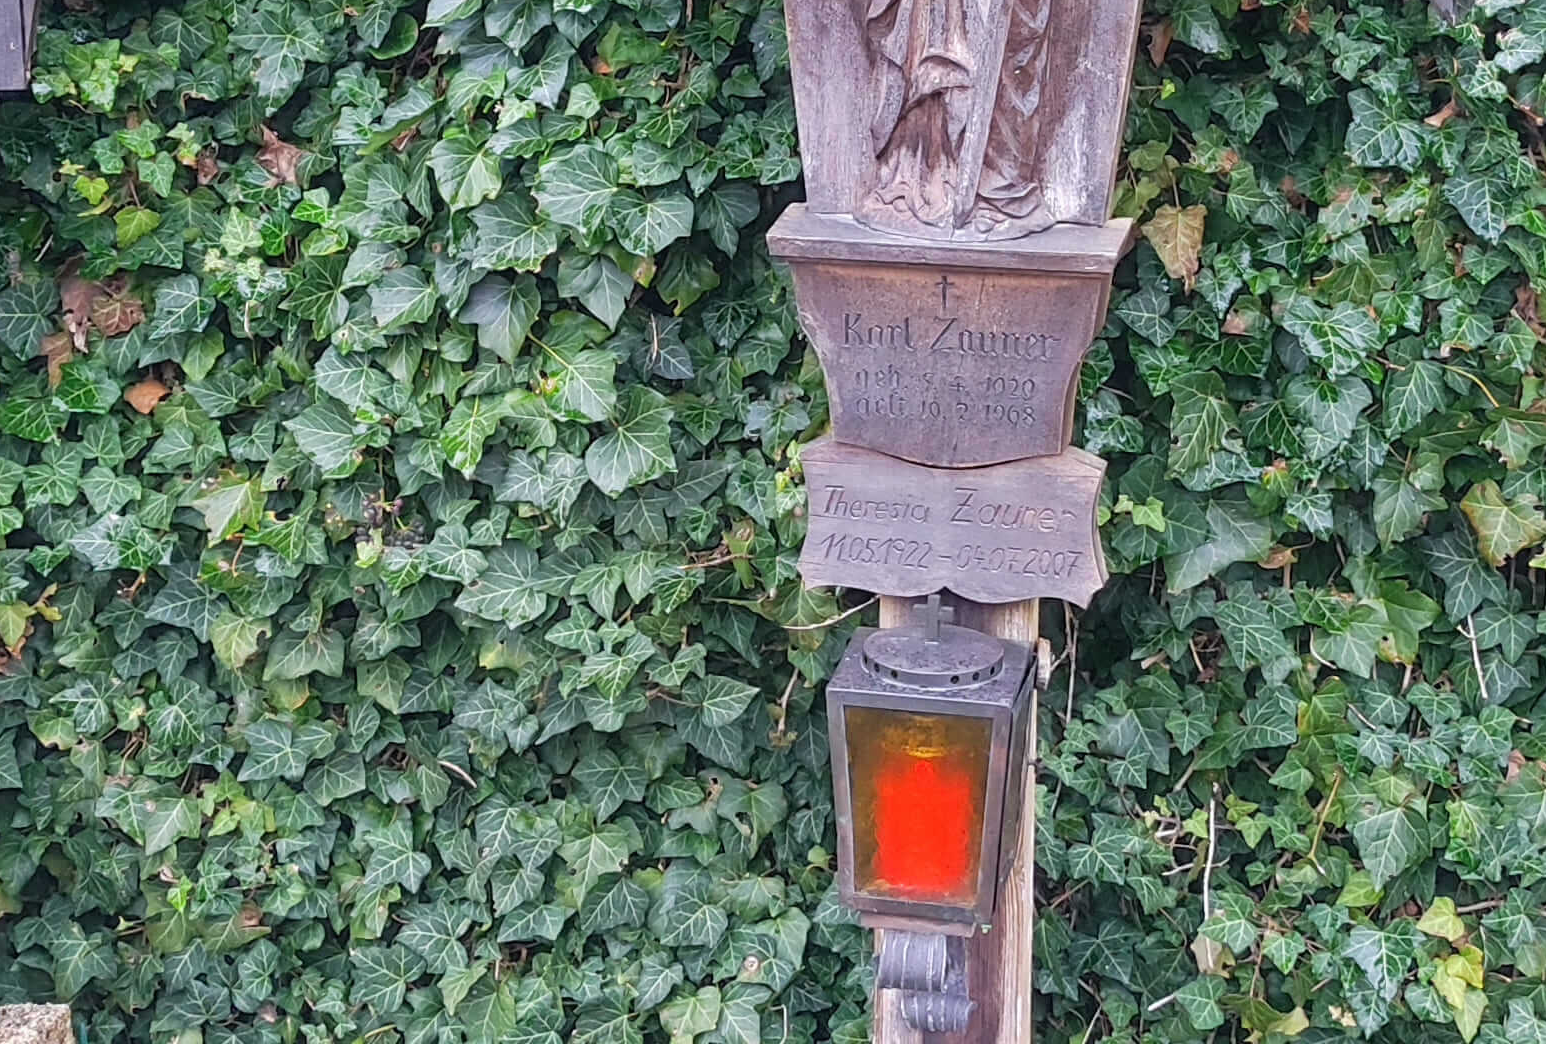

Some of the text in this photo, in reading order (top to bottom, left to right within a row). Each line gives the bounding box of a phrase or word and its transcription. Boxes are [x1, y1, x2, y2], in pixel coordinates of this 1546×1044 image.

[841, 312, 1062, 361] Karl Zauner
[824, 484, 1078, 535] Theresia Zauner
